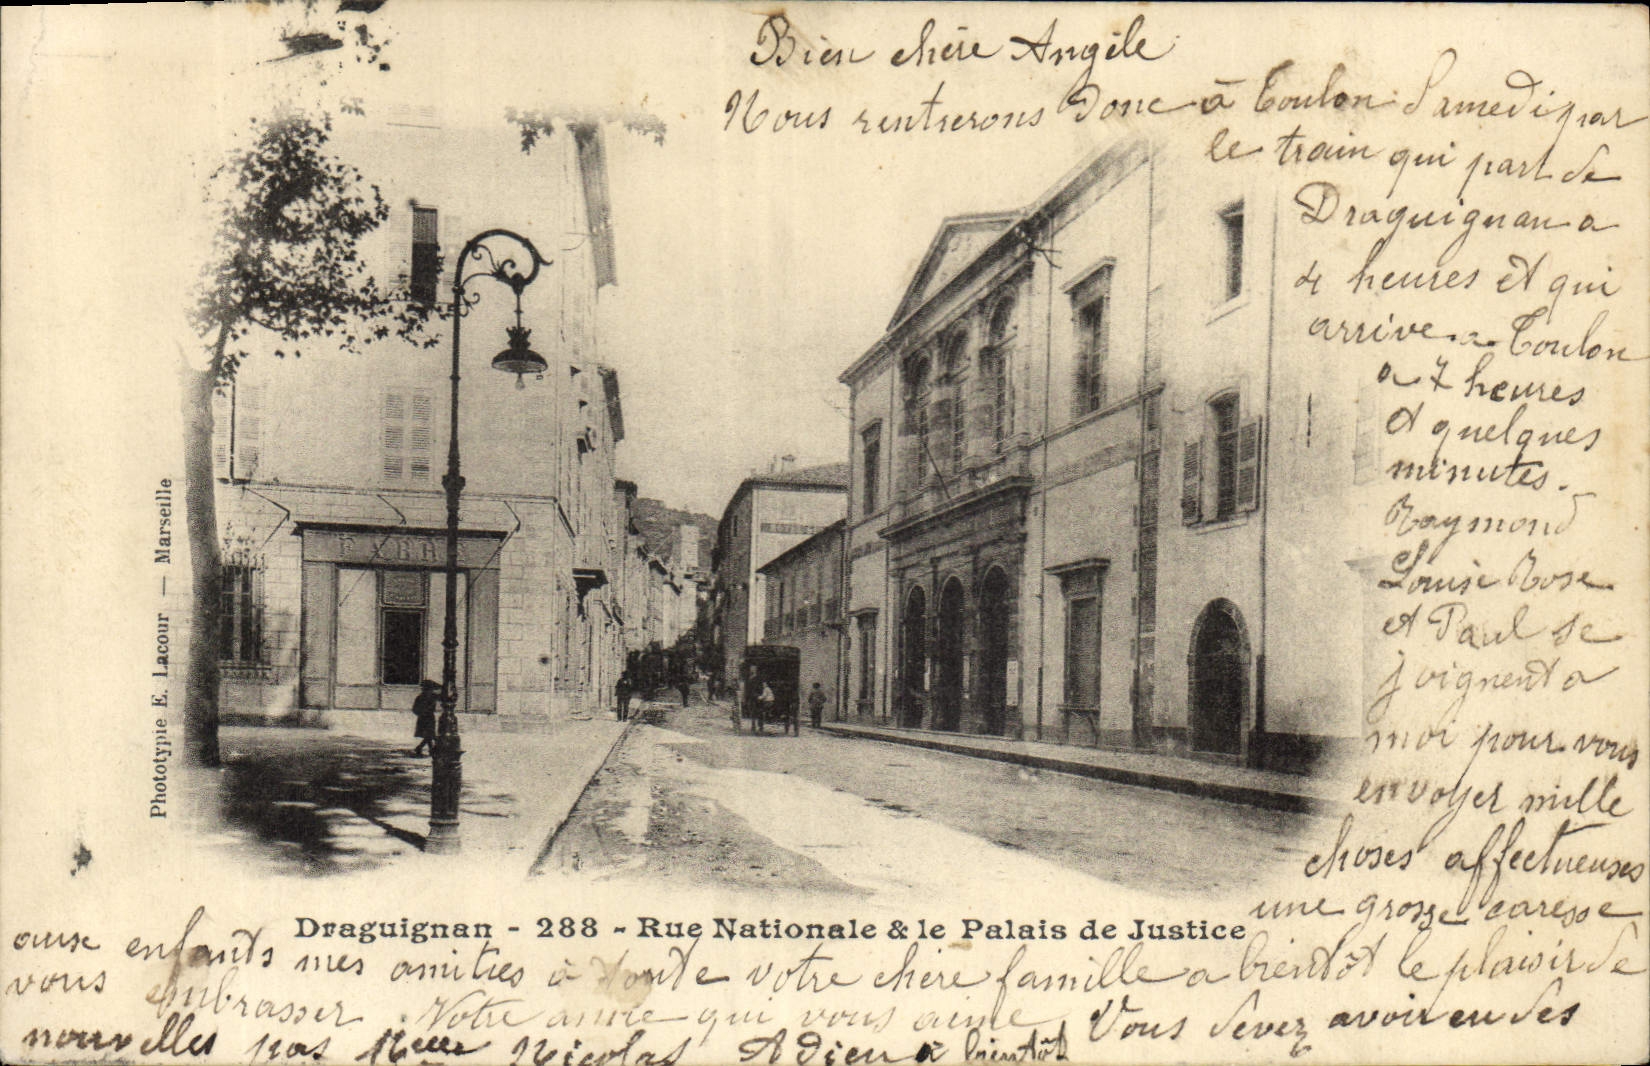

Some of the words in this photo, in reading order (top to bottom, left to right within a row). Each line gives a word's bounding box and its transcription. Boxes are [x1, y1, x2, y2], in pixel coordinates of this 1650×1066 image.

[751, 14, 874, 67] Bien
[724, 88, 831, 133] Nous
[852, 81, 1045, 135] rentrerons
[1254, 59, 1396, 114] Toulon
[1207, 128, 1261, 162] le
[1275, 125, 1383, 168] train
[1389, 142, 1457, 199] qui
[1457, 144, 1554, 204] part
[1294, 180, 1569, 264] Draguignan
[1294, 261, 1322, 295] 4
[1348, 238, 1480, 294] heures
[1549, 266, 1621, 323] qui
[1308, 314, 1454, 344] arrive
[1509, 306, 1648, 362] Toulon
[1464, 351, 1586, 406] heures
[1432, 402, 1601, 462] quelques
[1384, 491, 1597, 565] Raymond
[1378, 539, 1501, 596] Louise
[1508, 547, 1614, 592] Rose
[1428, 601, 1546, 649] Paul
[1366, 650, 1562, 726] joignent
[1364, 719, 1454, 754] moi
[1462, 721, 1566, 780] pour
[1573, 730, 1640, 770] vous
[1354, 775, 1505, 850] envoyer
[1519, 775, 1634, 818] mille
[1304, 812, 1415, 880] choses
[1445, 816, 1647, 910] affectueuses
[1250, 897, 1345, 920] une
[1356, 893, 1468, 931] grosse
[1484, 897, 1643, 928] caresse
[126, 905, 274, 1005] enfants
[294, 951, 365, 976] mes
[590, 938, 730, 991] toute
[747, 942, 863, 993] votre
[994, 941, 1184, 1029] famille
[1238, 922, 1385, 985] bientôt
[1400, 926, 1439, 982] le
[1430, 922, 1587, 1012] plaisir
[6, 970, 107, 996] vous
[145, 966, 363, 1027] embrasser
[416, 989, 546, 1032] Votre
[697, 996, 774, 1047] qui
[800, 1005, 897, 1033] vous
[1089, 994, 1189, 1042] Vous
[1208, 989, 1313, 1058] devez
[1328, 992, 1450, 1030] avoir
[1450, 1007, 1511, 1029] eu
[1511, 978, 1581, 1029] des
[21, 1011, 218, 1058] nouvelles
[509, 1028, 692, 1066] Nicolas
